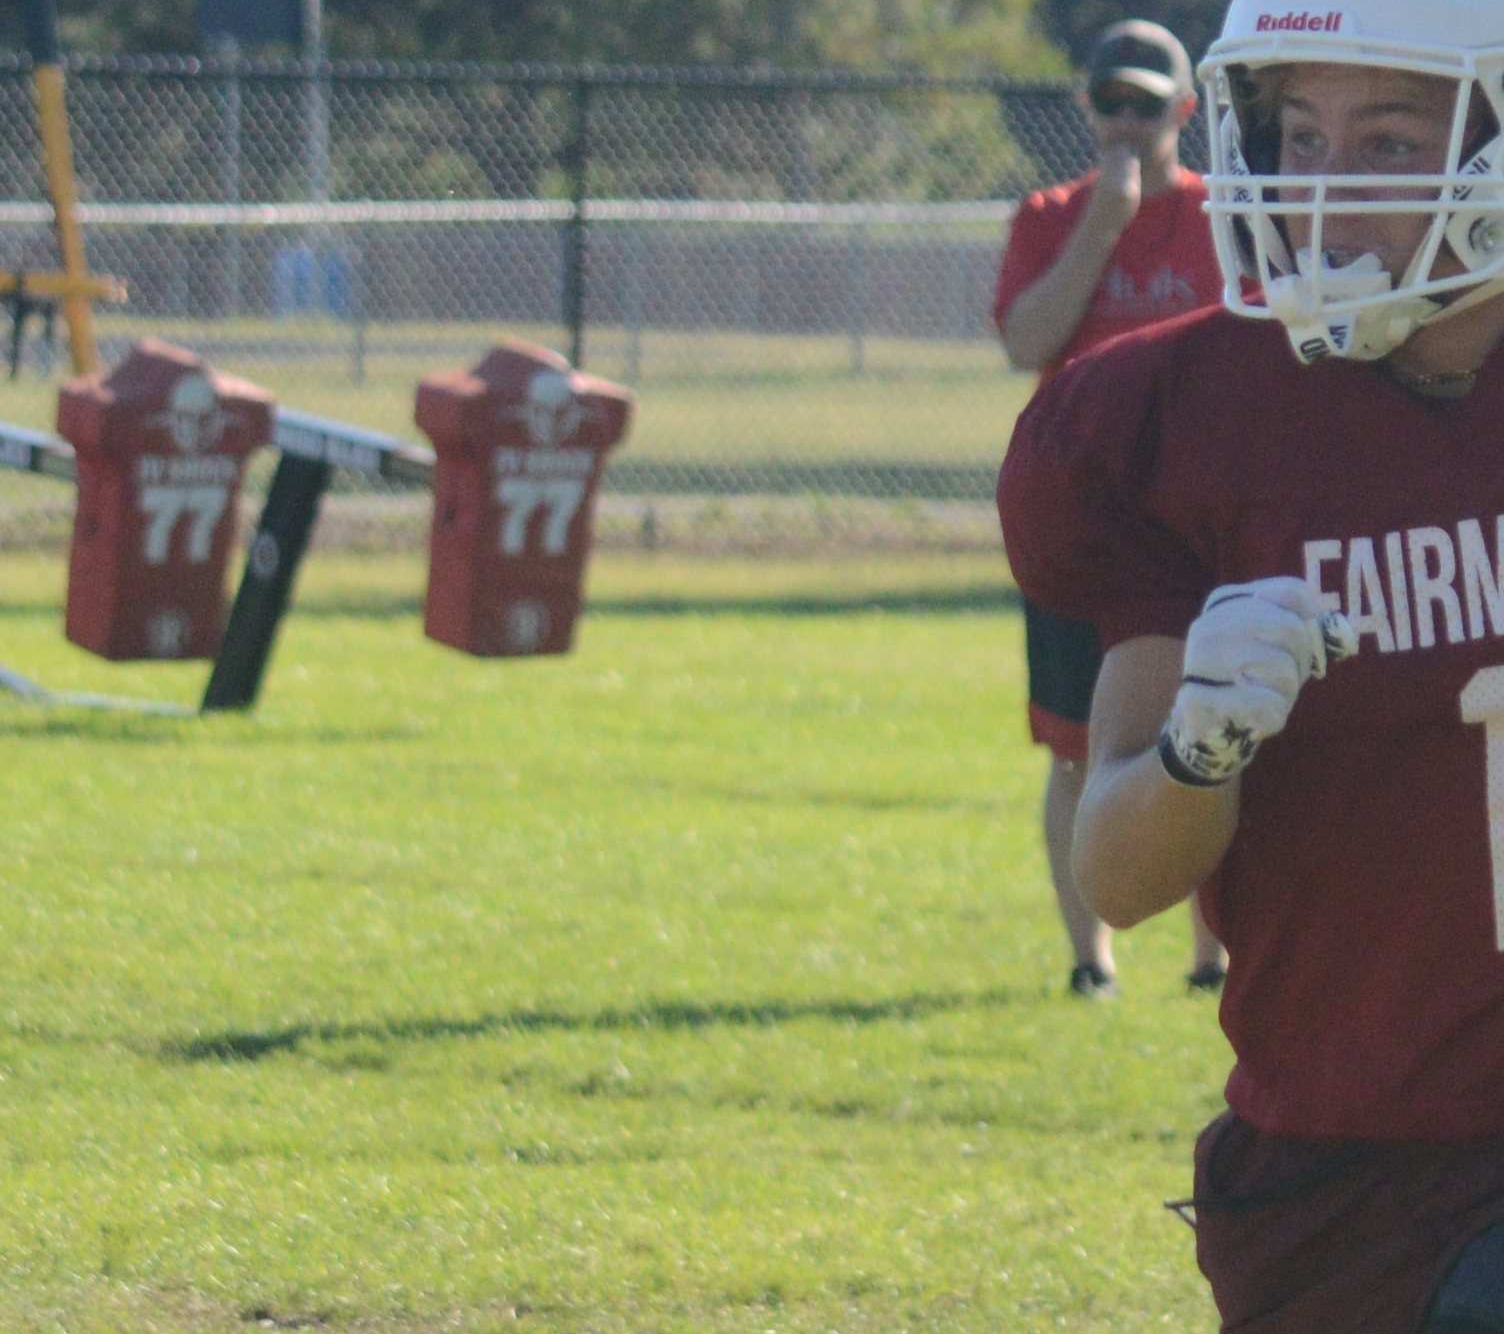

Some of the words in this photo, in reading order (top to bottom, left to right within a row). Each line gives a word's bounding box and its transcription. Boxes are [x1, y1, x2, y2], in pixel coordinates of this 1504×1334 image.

[1256, 11, 1343, 33] Riddell
[140, 486, 229, 565] 77
[496, 478, 587, 558] 77
